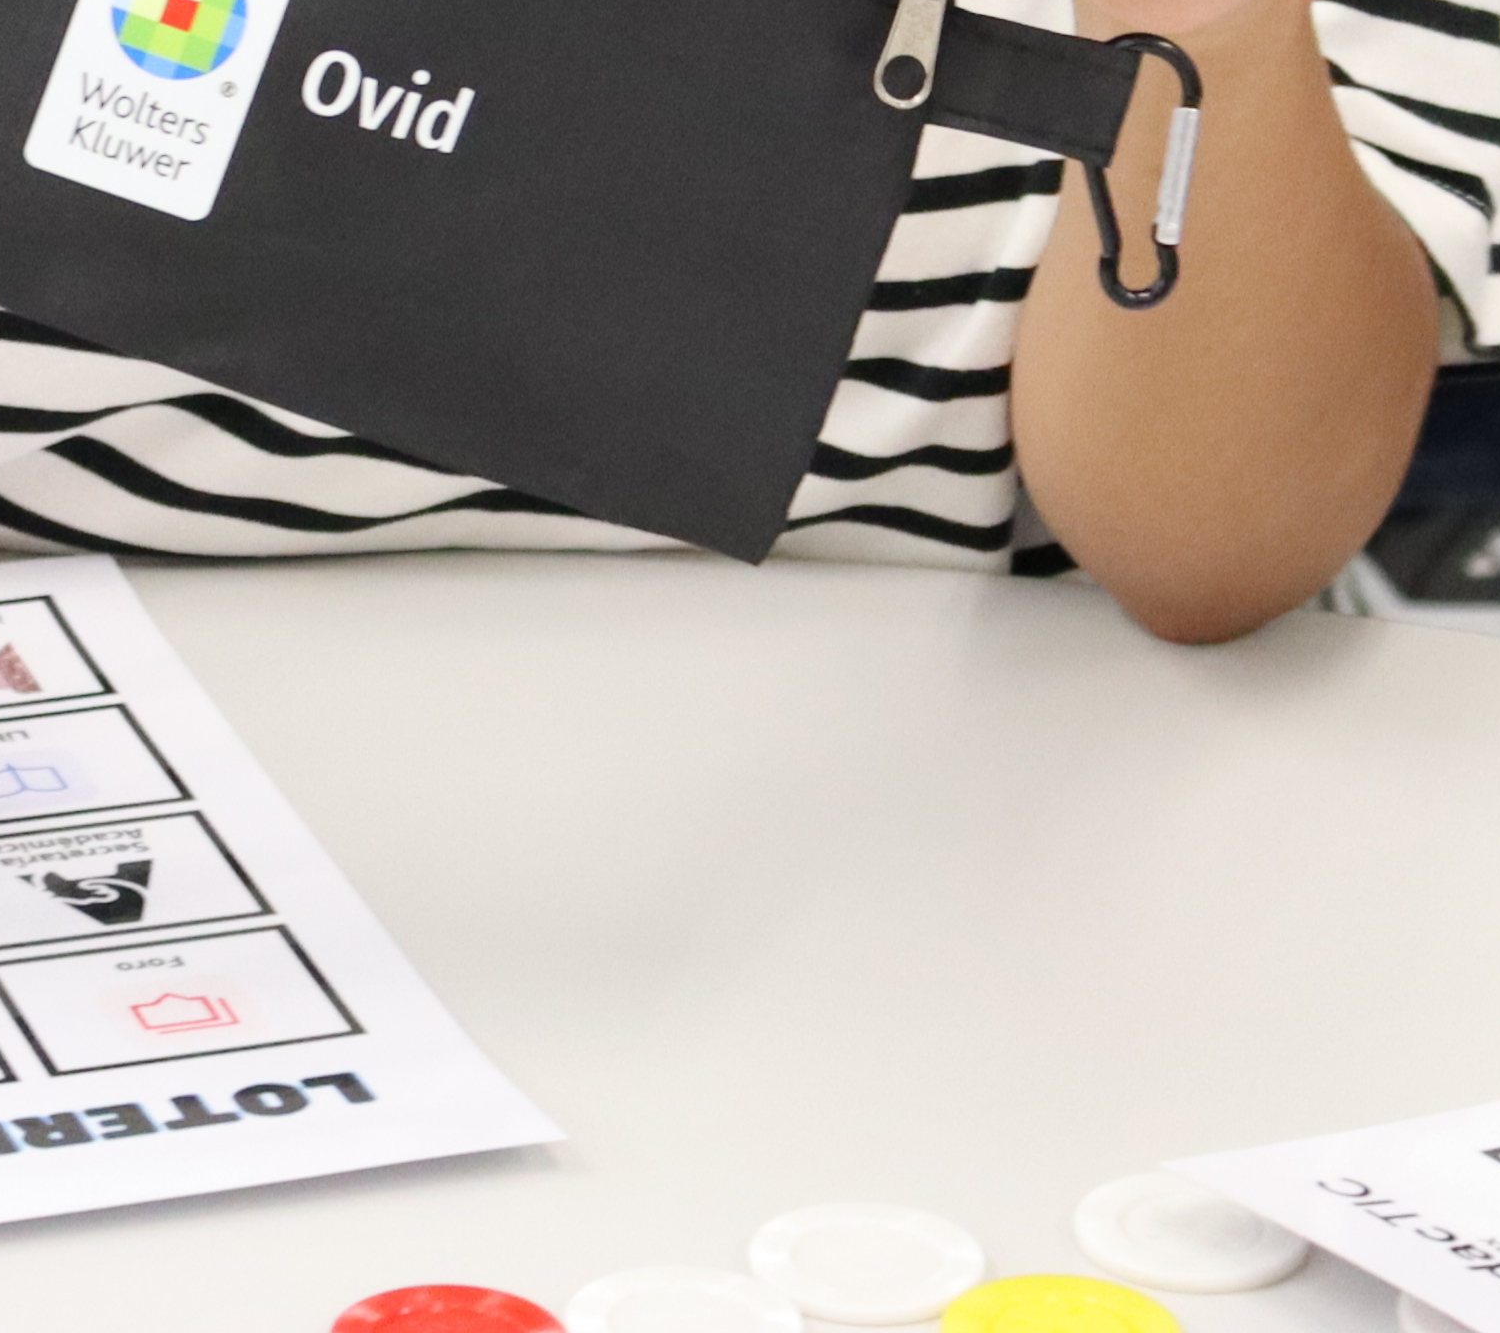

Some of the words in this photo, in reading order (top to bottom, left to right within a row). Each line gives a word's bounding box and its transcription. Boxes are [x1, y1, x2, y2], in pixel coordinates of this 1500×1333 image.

[79, 72, 211, 147] Wolters
[301, 49, 476, 153] Ovid
[67, 115, 193, 182] Kluwer
[115, 954, 185, 972] Foro
